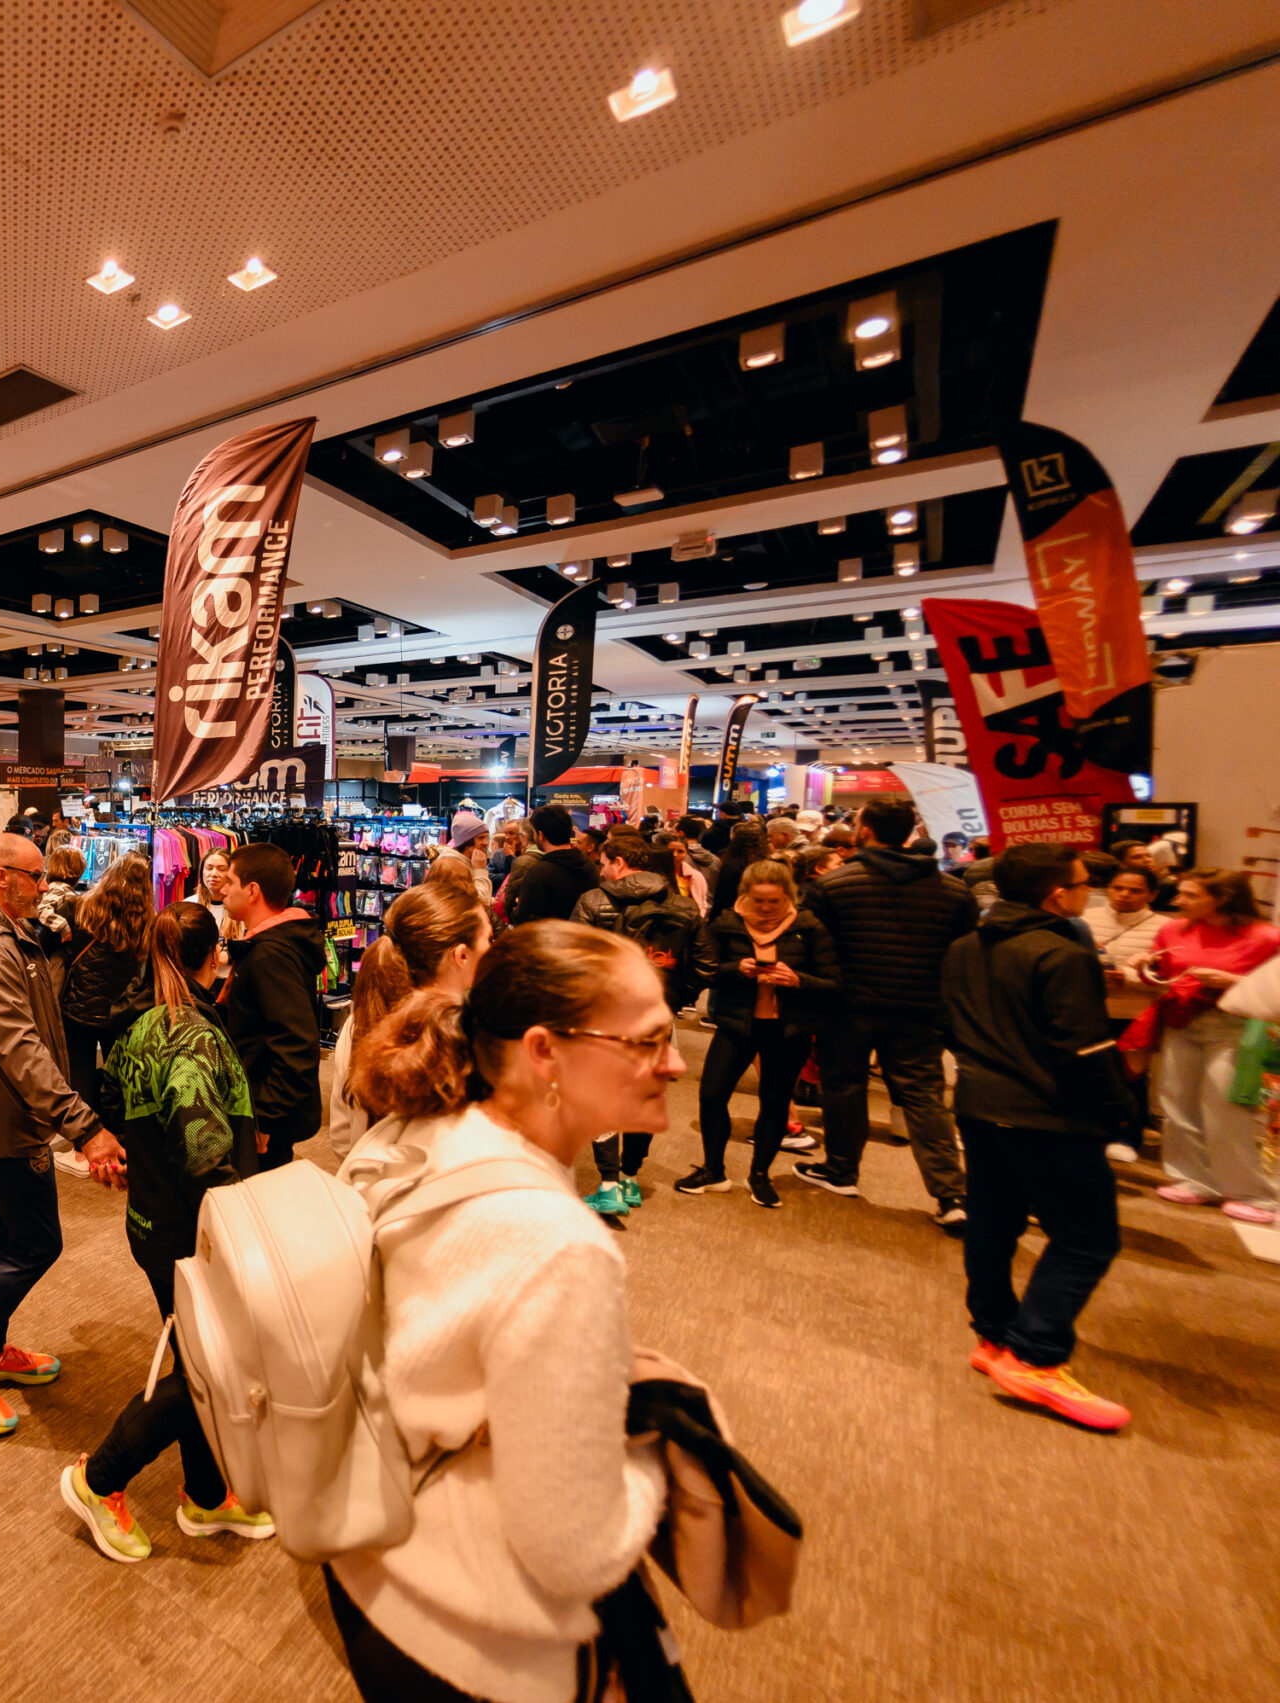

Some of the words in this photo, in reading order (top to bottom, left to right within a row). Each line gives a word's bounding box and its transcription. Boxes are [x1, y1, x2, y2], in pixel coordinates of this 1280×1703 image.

[168, 484, 267, 739] rikam
[246, 519, 289, 700] PERFORMANCE
[270, 682, 282, 748] CTORIA
[545, 652, 568, 757] VICTORIA
[999, 804, 1049, 819] CORRA
[1052, 802, 1082, 814] SEM
[1002, 817, 1059, 833] BOLHAS
[1063, 817, 1073, 828] E
